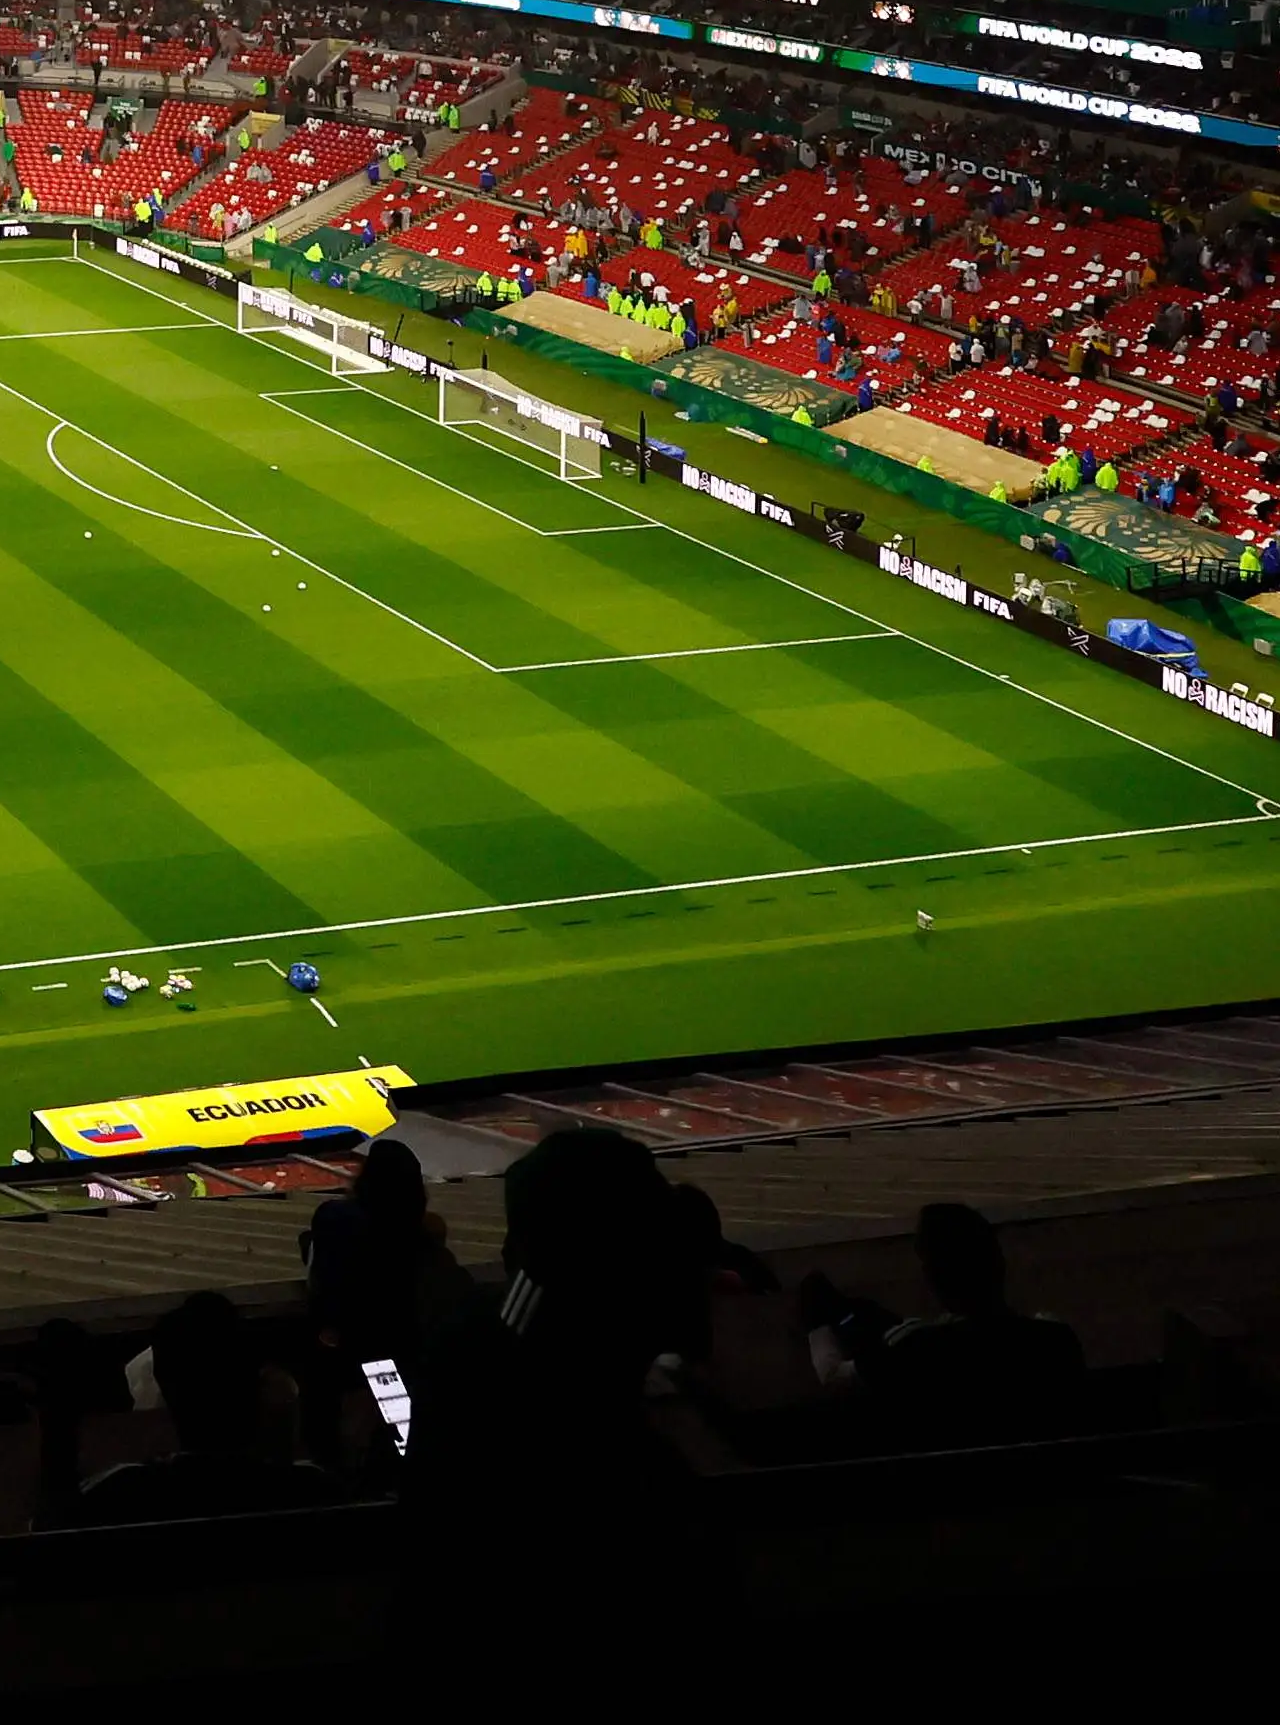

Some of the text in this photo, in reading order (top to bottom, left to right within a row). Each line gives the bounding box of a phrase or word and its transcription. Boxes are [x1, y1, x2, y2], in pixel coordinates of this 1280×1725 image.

[711, 29, 821, 61] MEXICO CITY
[979, 17, 1020, 40] FIFA
[1020, 23, 1088, 51] WORLD
[1089, 36, 1130, 57] CUP
[978, 76, 1019, 99] FIFA
[1019, 83, 1087, 112] WORLD
[1088, 97, 1129, 121] CUP
[4, 225, 30, 237] FIFA
[161, 257, 181, 274] FIFA
[583, 424, 612, 449] FIFA
[682, 463, 795, 527] NO RACISM FIFA
[879, 546, 1014, 621] NO RACISM FIFA
[1162, 666, 1274, 737] NO RACISM
[186, 1092, 328, 1123] ECUADOR
